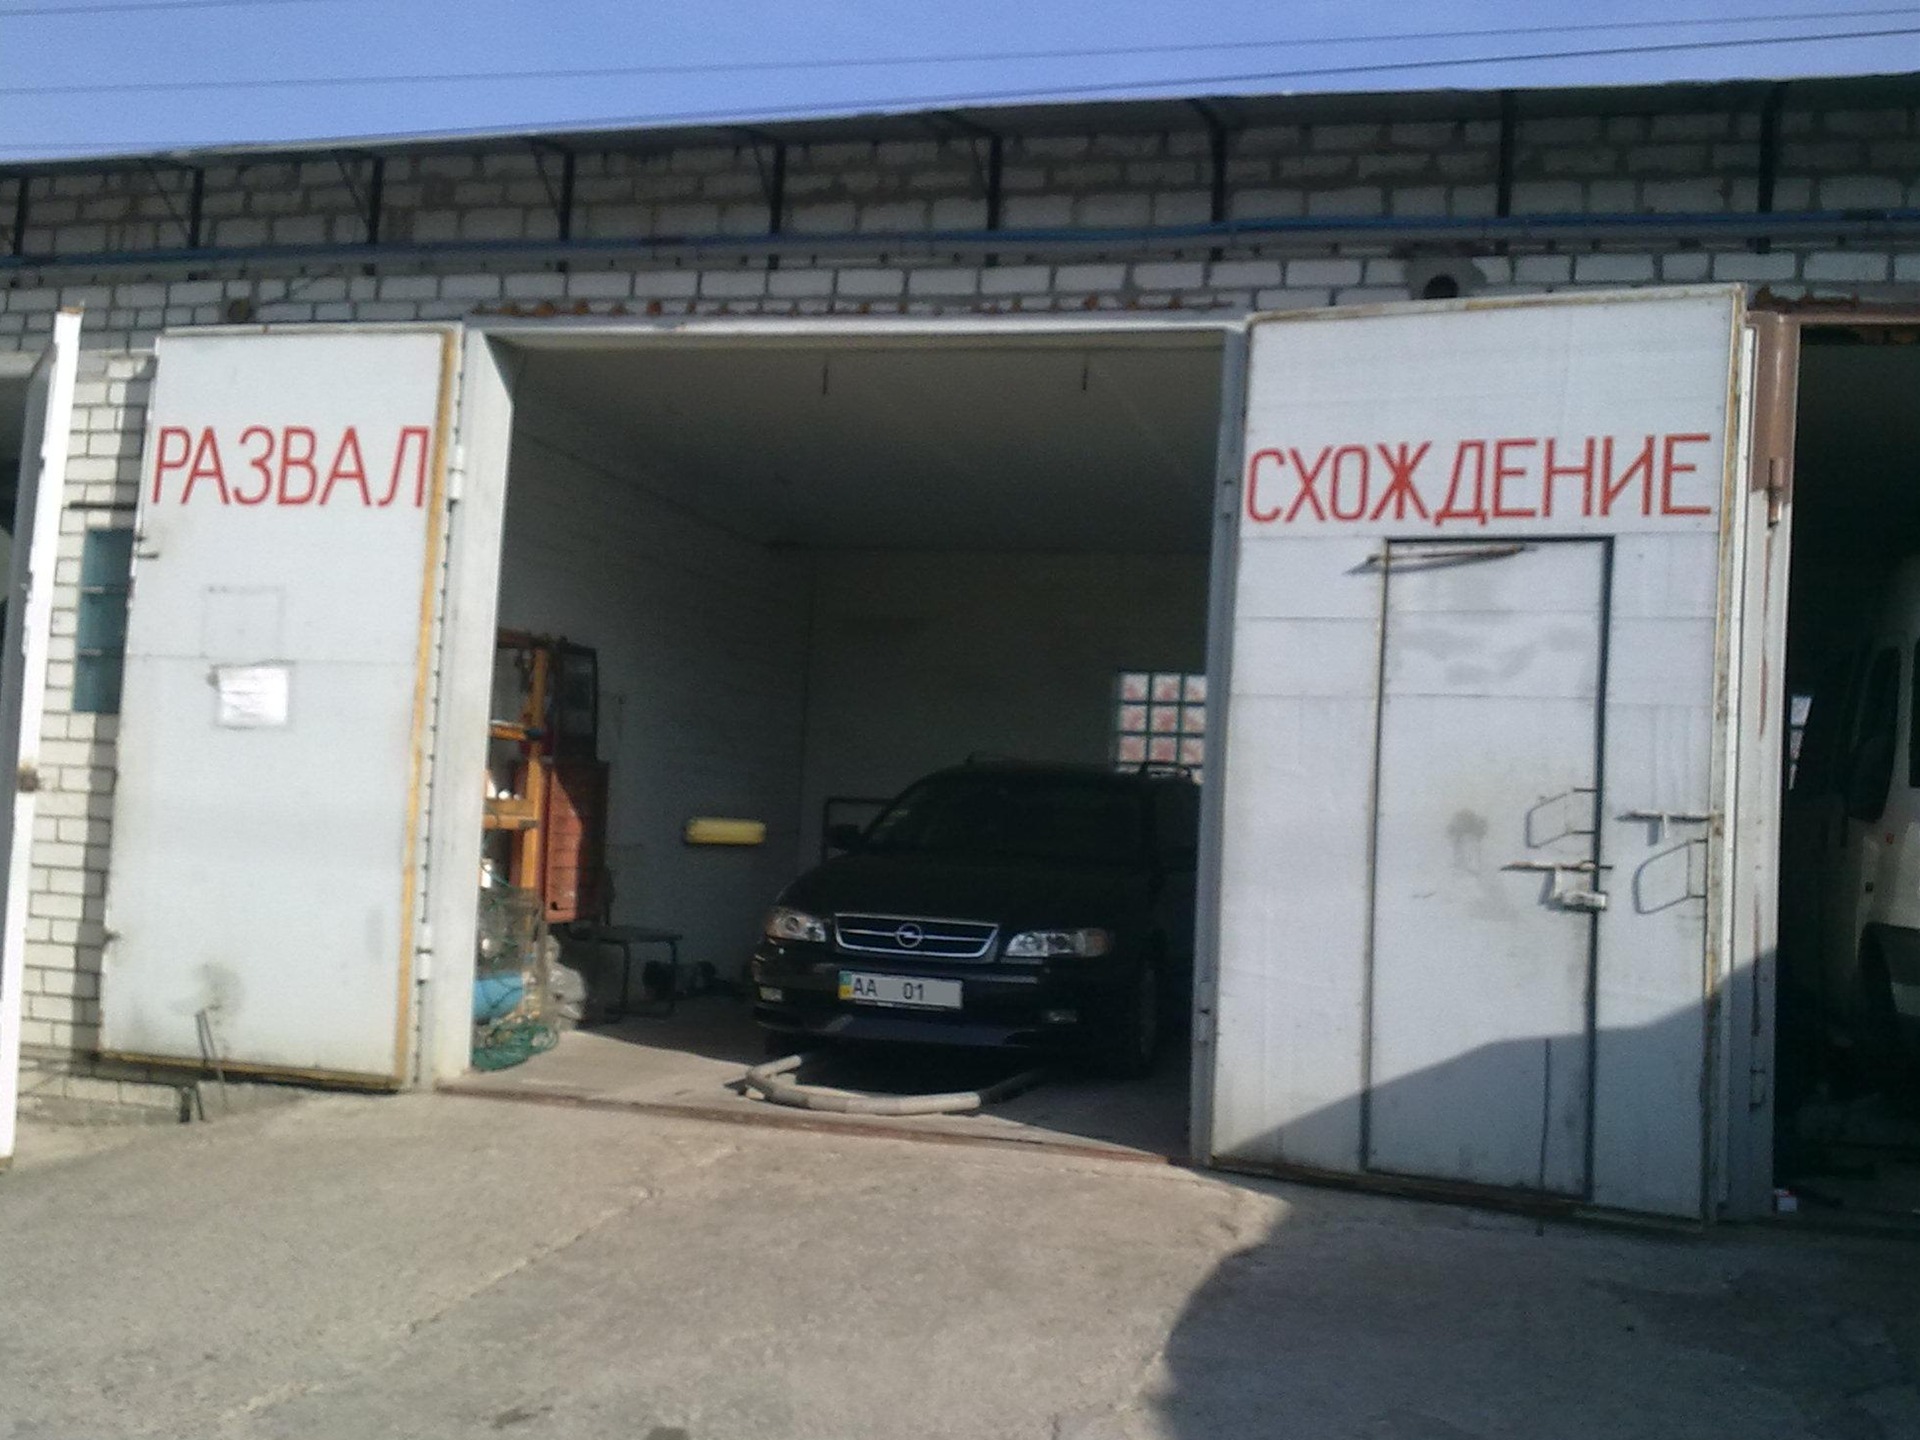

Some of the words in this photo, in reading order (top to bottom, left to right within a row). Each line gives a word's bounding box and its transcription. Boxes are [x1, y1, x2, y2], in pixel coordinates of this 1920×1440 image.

[152, 426, 432, 507] РАЗВАЛ
[1246, 433, 1712, 525] СХОЖДЕНИЕ
[853, 977, 878, 997] AA
[903, 982, 924, 1001] 01
